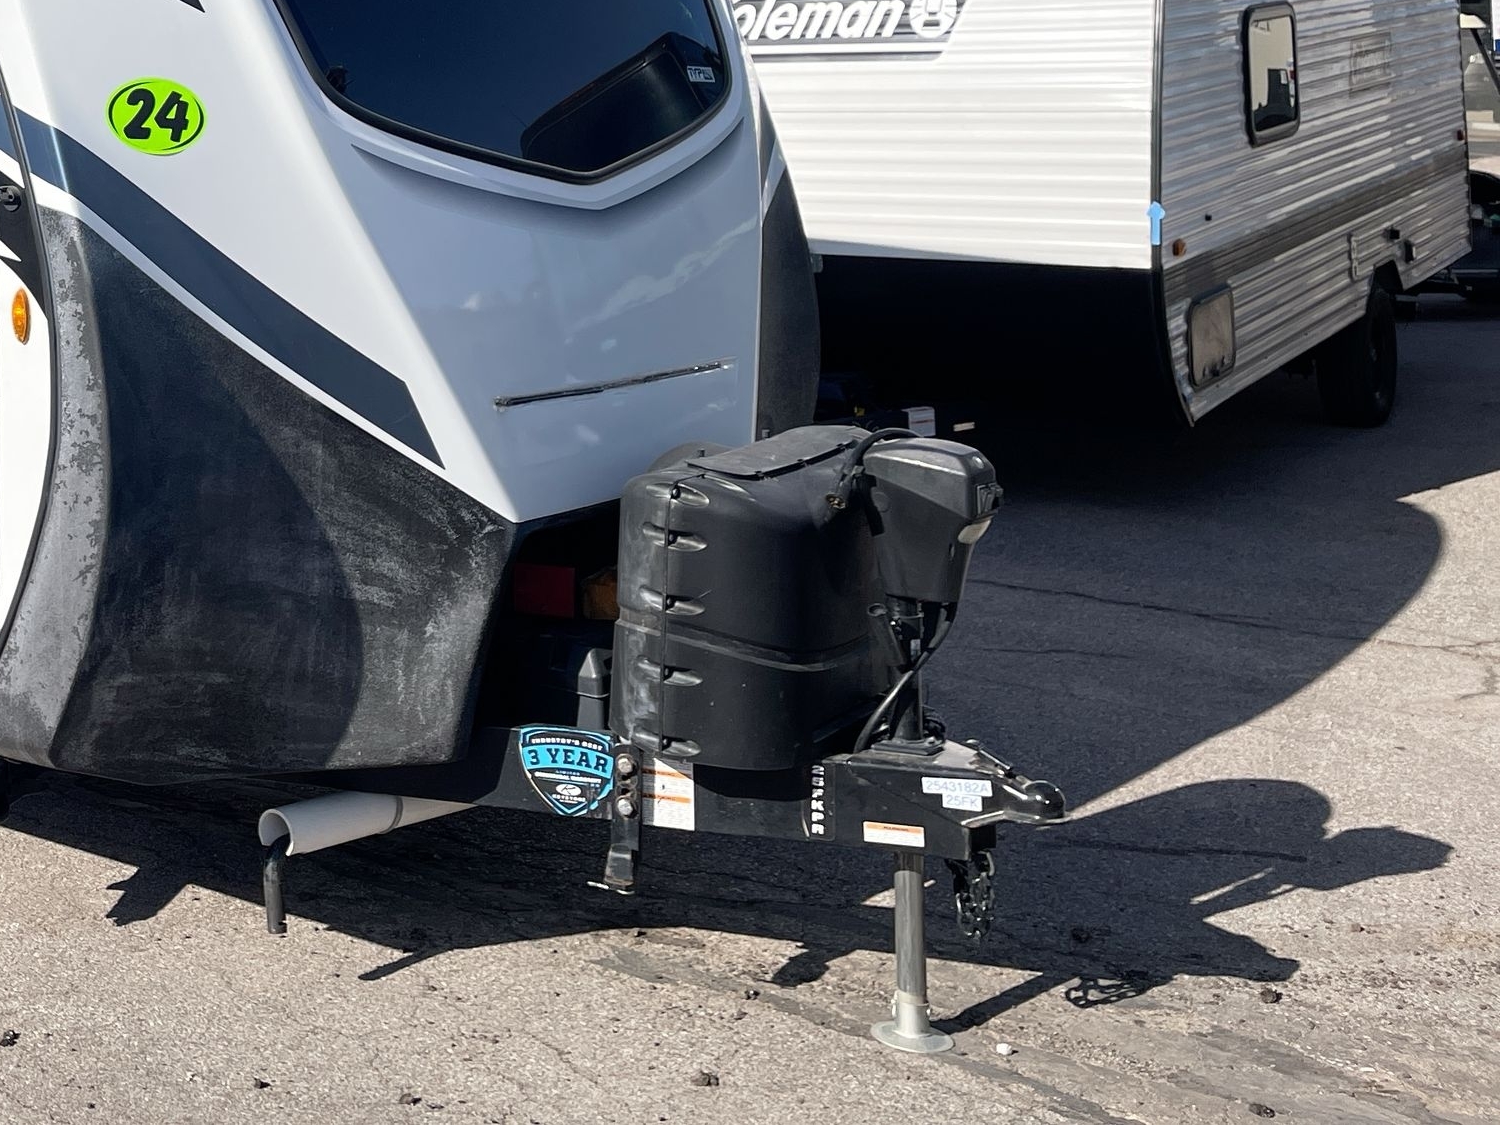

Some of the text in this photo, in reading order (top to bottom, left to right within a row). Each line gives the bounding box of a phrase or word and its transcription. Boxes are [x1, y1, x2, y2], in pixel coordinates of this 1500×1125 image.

[123, 88, 190, 143] 24
[527, 747, 609, 774] 3 YEAR
[946, 794, 979, 808] 25FK
